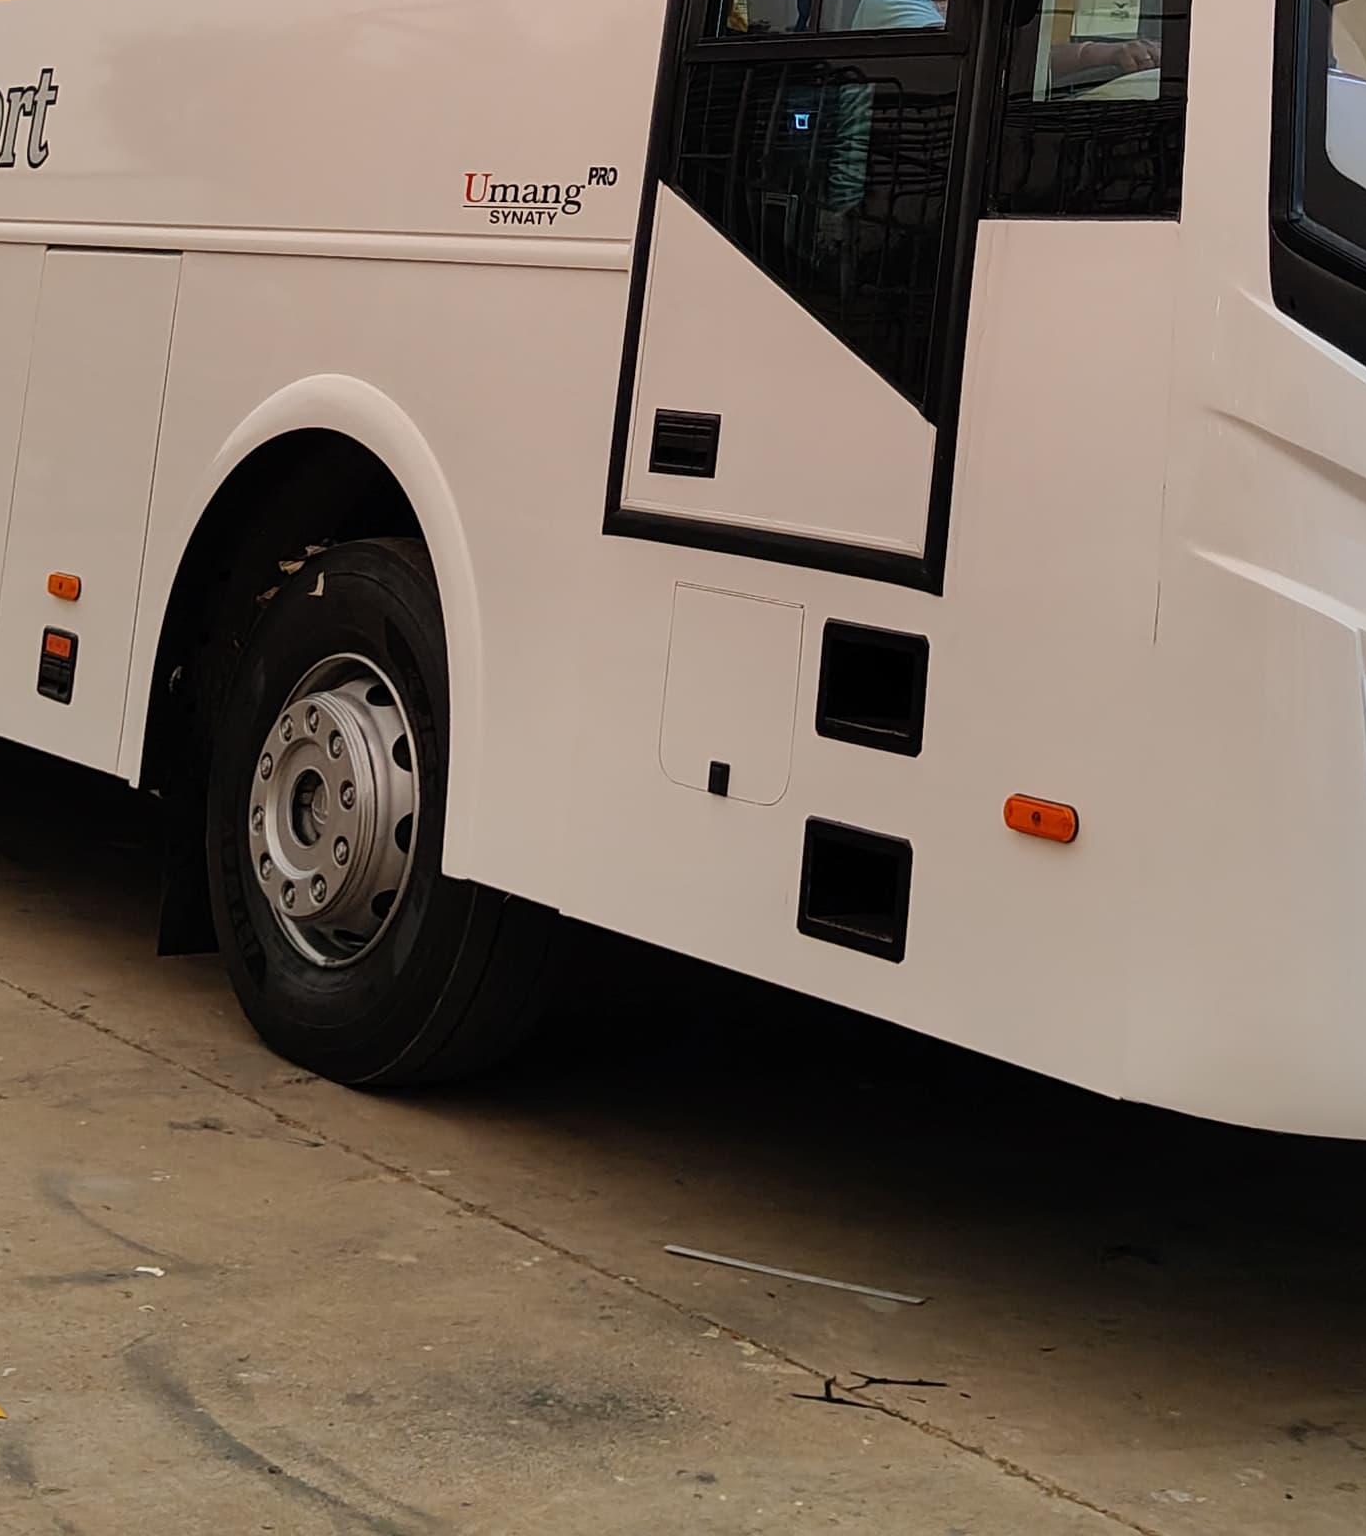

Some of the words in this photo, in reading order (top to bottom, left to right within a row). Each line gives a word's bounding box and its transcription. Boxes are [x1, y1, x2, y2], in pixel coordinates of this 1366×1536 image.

[464, 172, 585, 215] Umang
[588, 167, 618, 186] PRO
[489, 210, 557, 225] SYNATY
